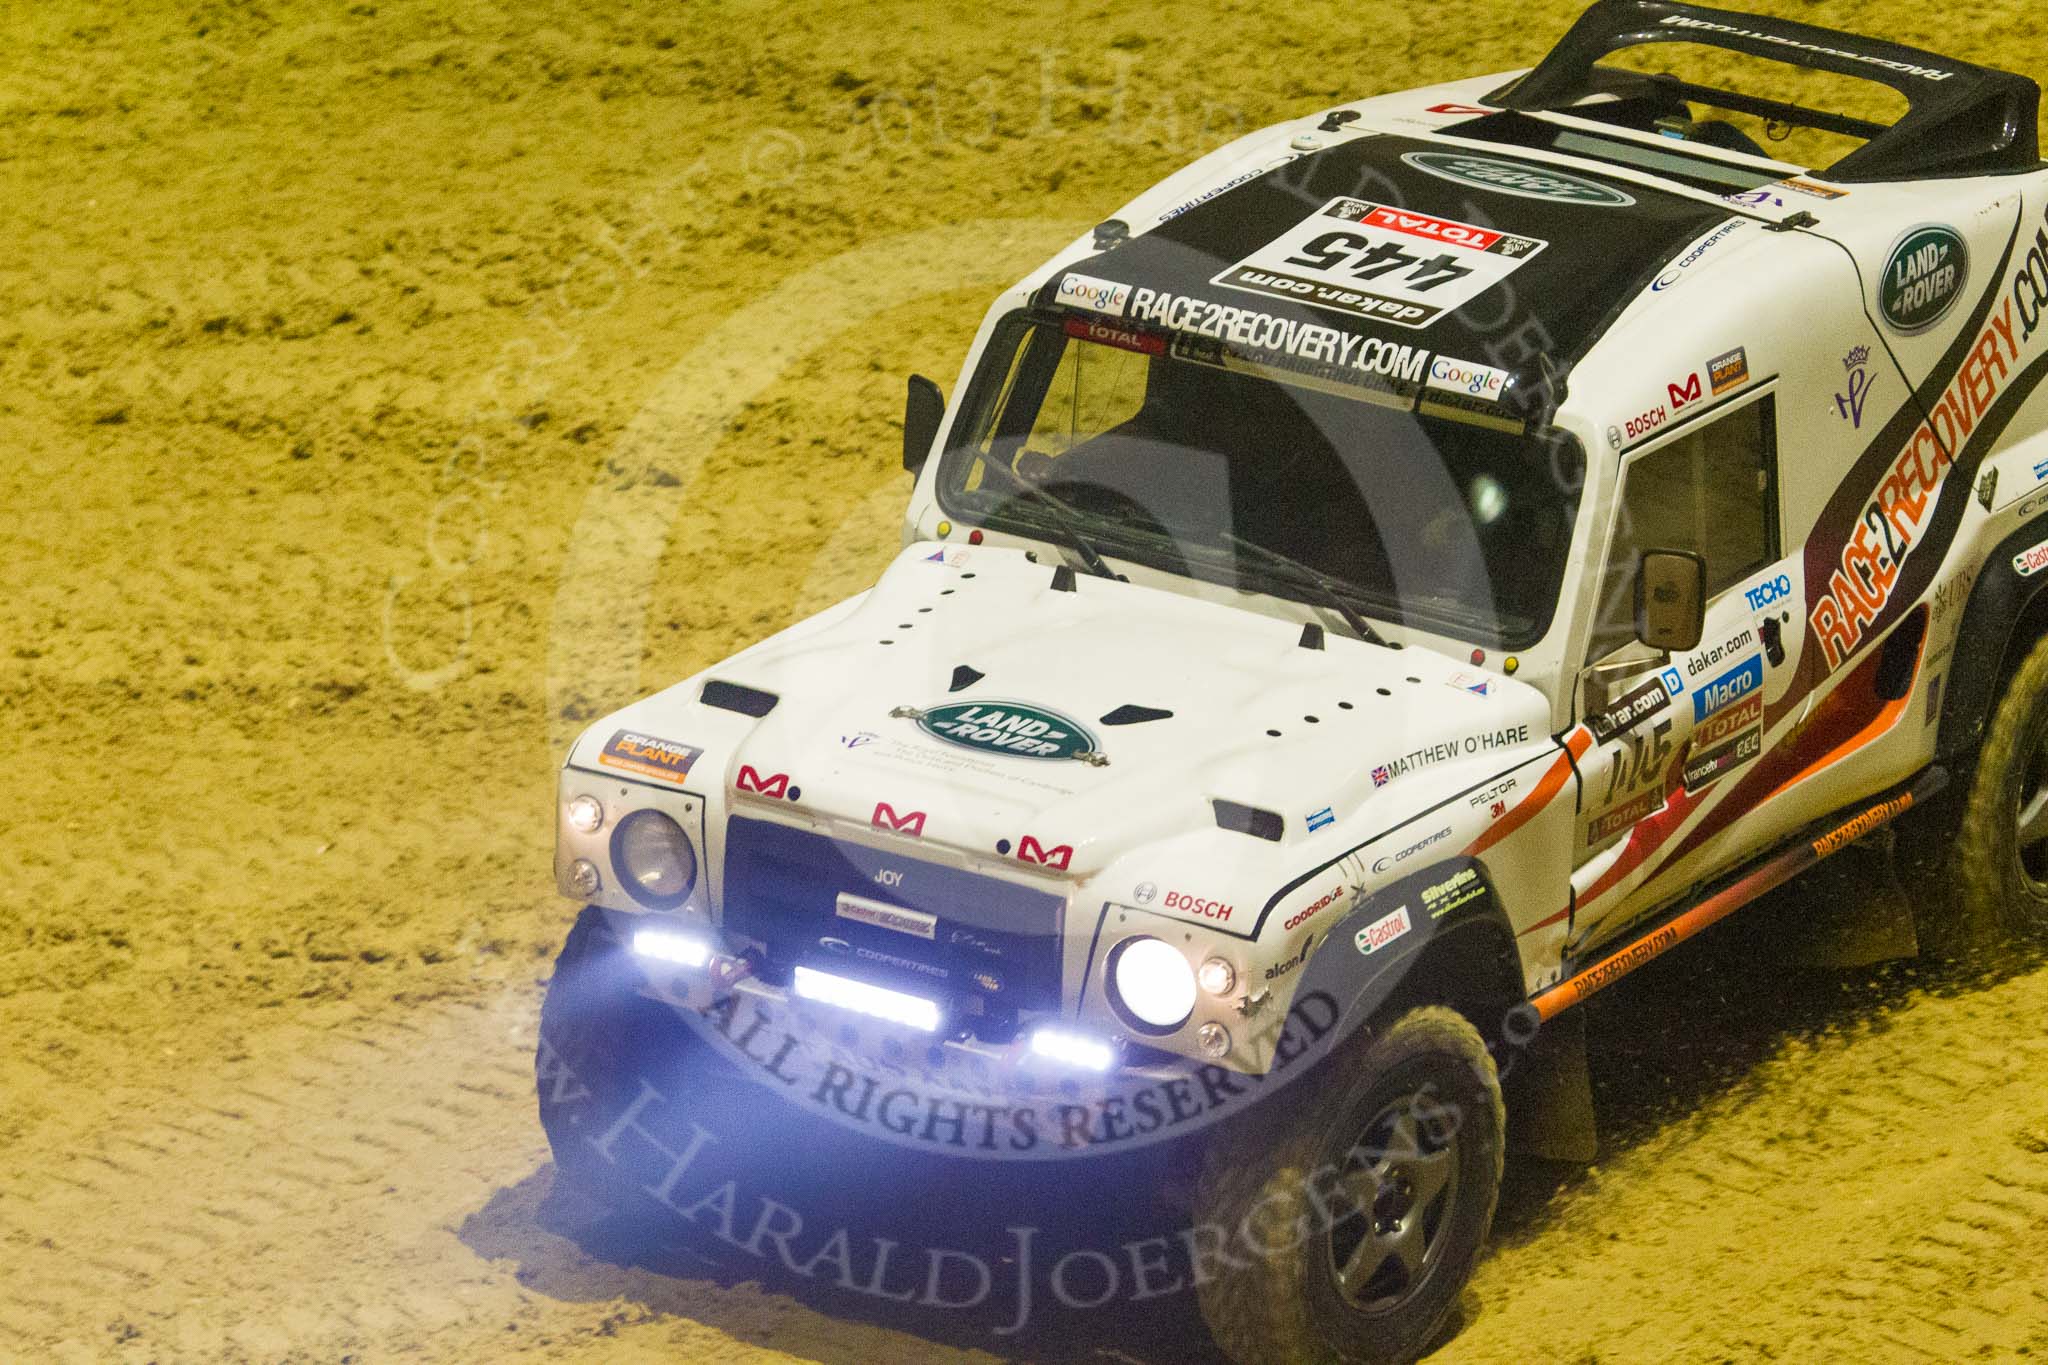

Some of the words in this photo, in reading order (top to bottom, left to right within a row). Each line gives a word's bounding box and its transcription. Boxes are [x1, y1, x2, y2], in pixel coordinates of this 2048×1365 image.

[1376, 210, 1485, 249] TOTAL
[1678, 219, 1746, 268] COOPERTIRES
[1284, 231, 1474, 292] 445
[1896, 242, 1938, 288] LAND
[1239, 271, 1425, 319] dakar.com
[1901, 264, 1956, 315] ROVER
[1061, 277, 1125, 309] Google
[1130, 287, 1430, 382] RACE2RECOVERY.COM
[1432, 360, 1501, 393] Google
[1088, 325, 1142, 346] TOTAL
[1711, 352, 1744, 372] ORANGE
[1713, 361, 1743, 382] PLANT
[1625, 405, 1666, 439] BOSCH
[1744, 574, 1791, 612] TECHO
[1687, 629, 1753, 676] dakar.com
[1704, 670, 1752, 713] Macro
[949, 722, 1060, 756] ROVER
[956, 706, 1050, 738] LAND
[1706, 704, 1760, 740] TOTAL
[615, 740, 686, 766] PLANT
[622, 733, 692, 757] ORANGE
[1387, 739, 1459, 779] MATTHEW
[1464, 725, 1529, 754] O'HARE
[1470, 778, 1517, 808] PELTOR
[1490, 800, 1506, 819] 3M
[1395, 826, 1452, 862] COOPERTIRES
[874, 868, 904, 887] JOY
[1164, 891, 1233, 921] BOSCH
[1284, 886, 1345, 930] GOODRIDGE
[1369, 913, 1405, 946] Castrol
[1265, 954, 1300, 980] alcon
